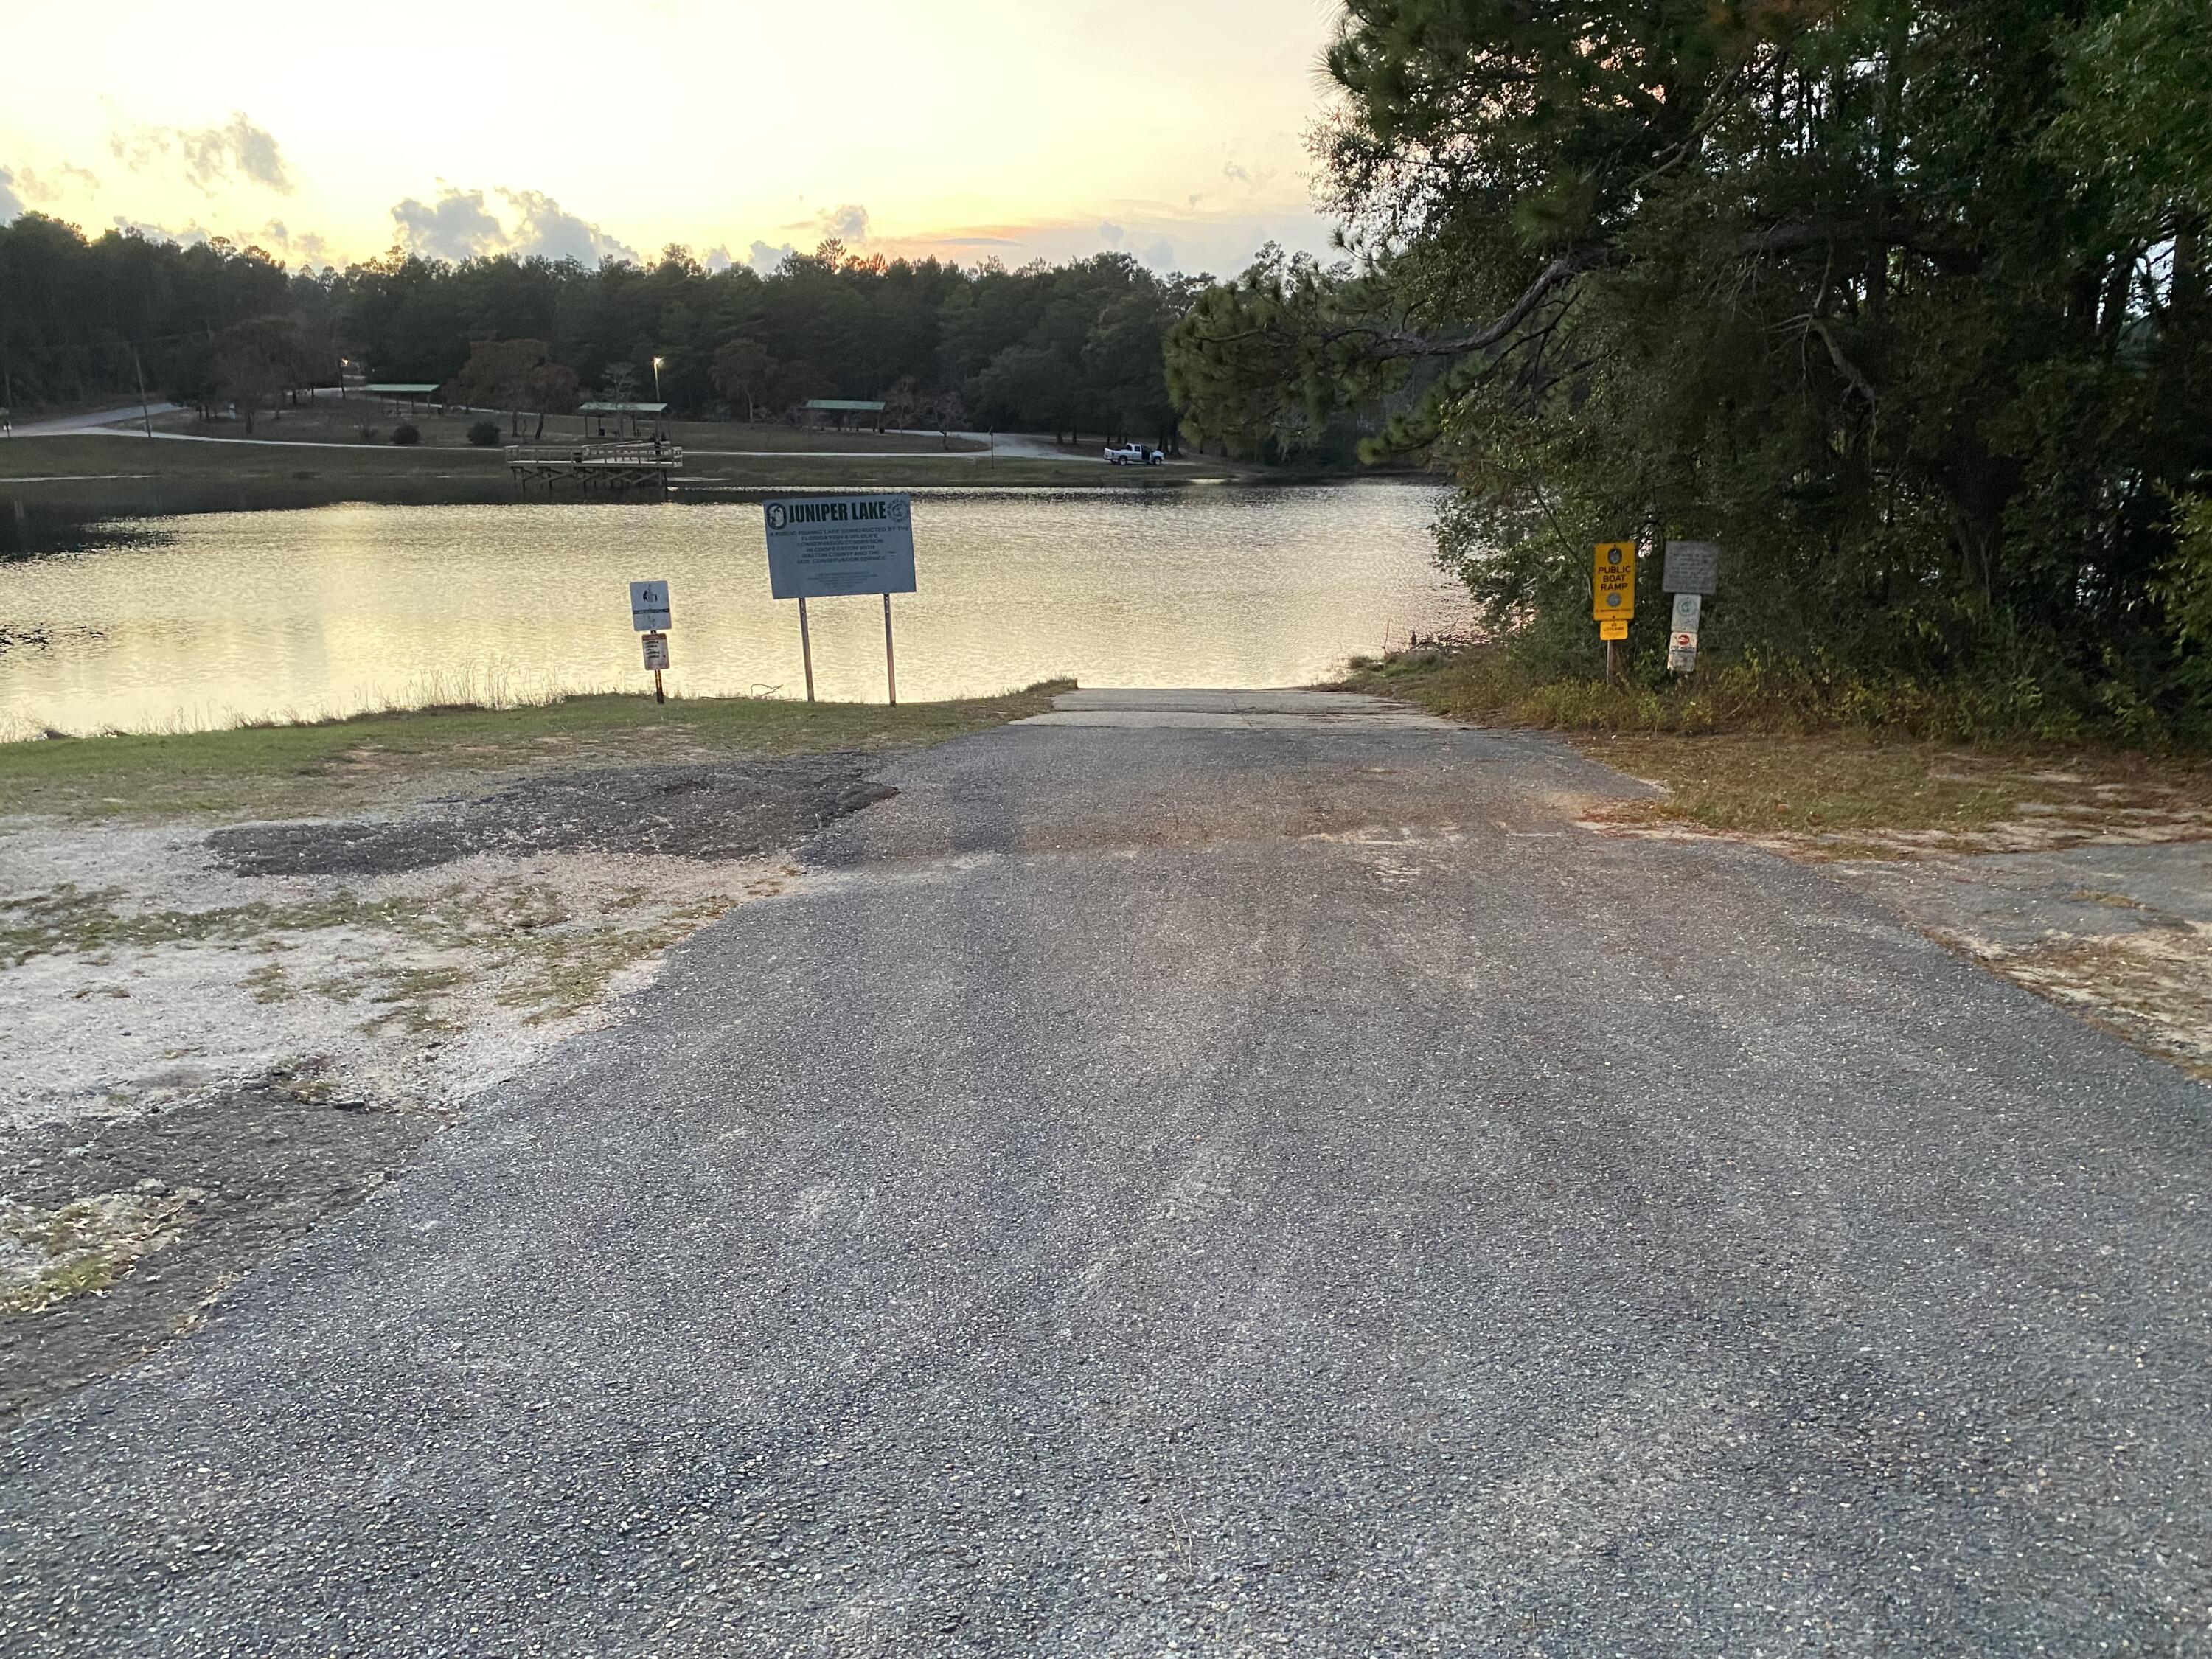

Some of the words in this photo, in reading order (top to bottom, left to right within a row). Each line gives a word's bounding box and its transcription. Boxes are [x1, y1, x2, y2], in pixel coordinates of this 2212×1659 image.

[789, 503, 848, 523] JUNIPER
[852, 501, 886, 520] LAKE
[1598, 566, 1631, 574] PUBLIC
[1603, 574, 1625, 582] BOAT
[1601, 582, 1628, 591] RAMP
